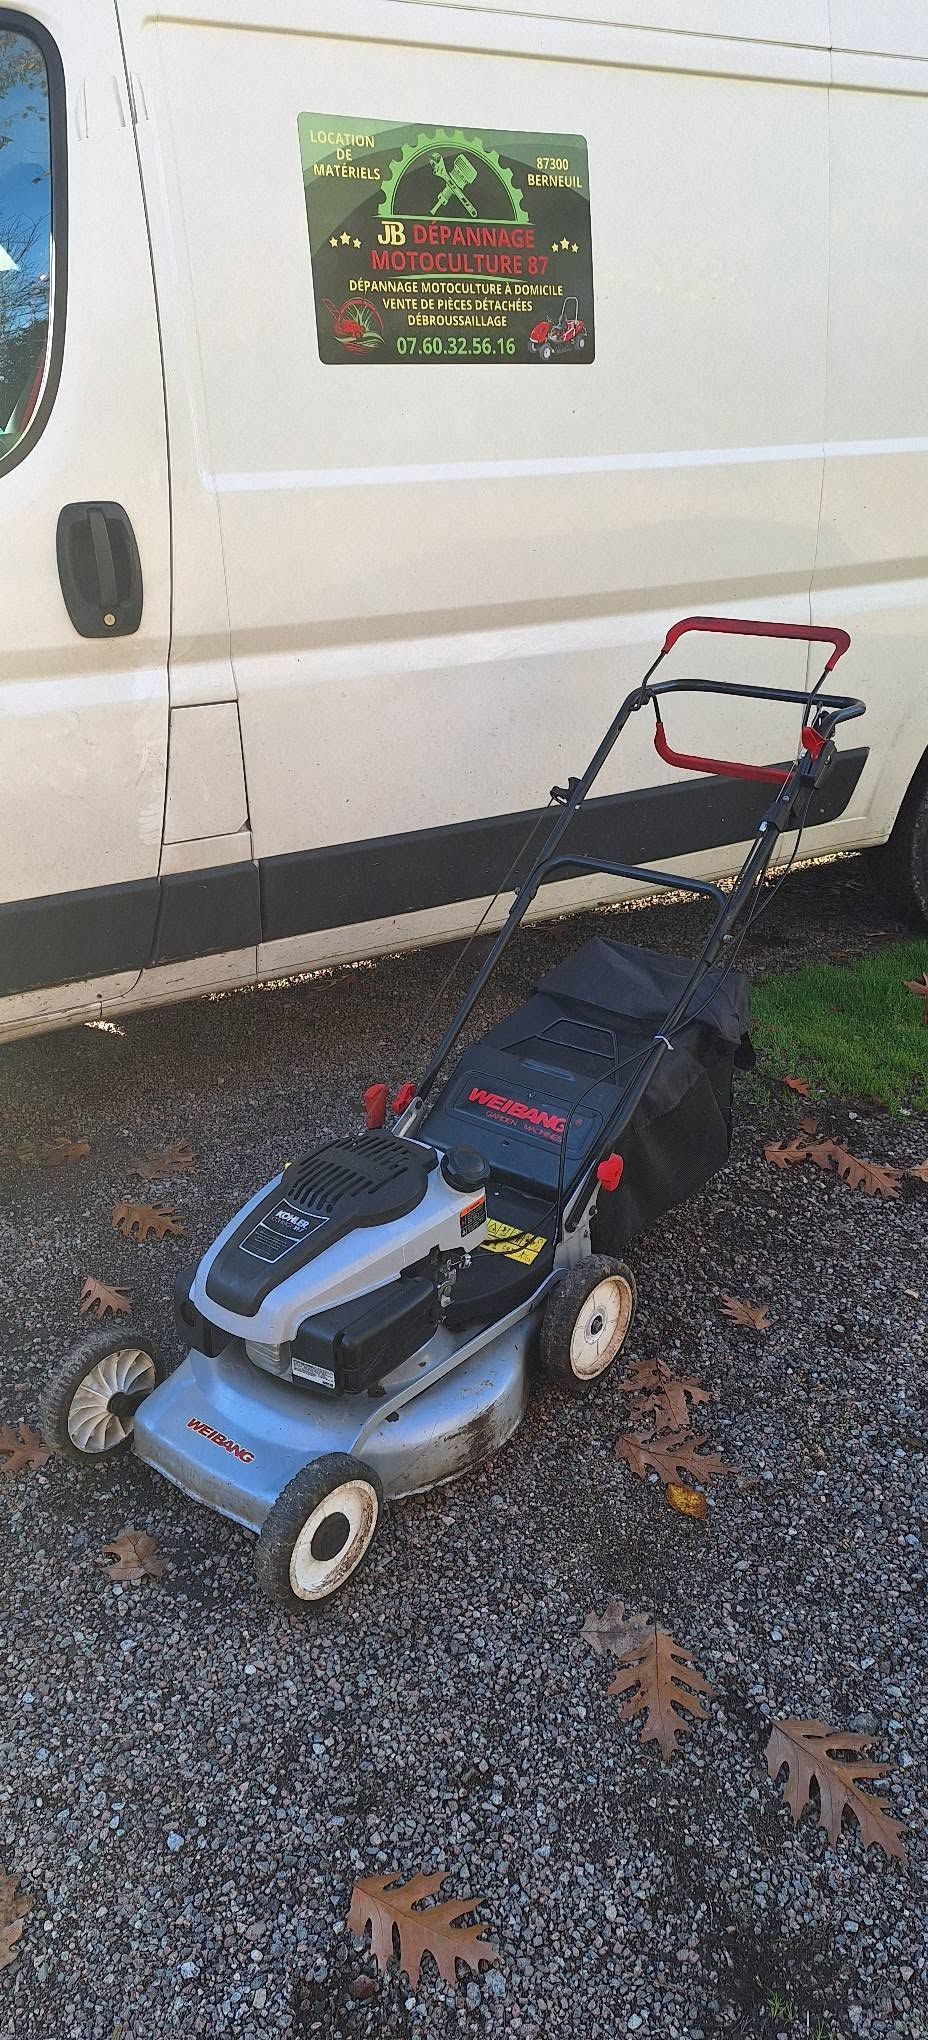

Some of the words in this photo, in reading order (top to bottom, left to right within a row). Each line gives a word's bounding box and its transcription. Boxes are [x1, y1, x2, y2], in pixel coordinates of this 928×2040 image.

[310, 130, 375, 148] LOCATION
[336, 149, 353, 161] DE
[536, 157, 569, 171] 87300
[313, 162, 381, 180] MATÉRIELS
[527, 174, 583, 188] BERNEUIL
[377, 221, 406, 246] JB
[413, 221, 535, 248] DÉPANNAGE
[371, 251, 523, 275] MOTOCULTURE
[527, 256, 548, 276] 87
[349, 278, 419, 293] DÉPANNAGE
[421, 282, 502, 295] MOTOCULTURE
[504, 280, 513, 295] À
[515, 284, 563, 296] DOMICILE
[382, 298, 418, 310] VENTE
[420, 298, 435, 310] DE
[437, 296, 472, 311] PIÈCES
[475, 298, 533, 312] DÉTACHÉES
[408, 312, 508, 327] DÉBROUSSAILLAGE
[396, 337, 516, 356] 07.60.32.56.16
[468, 1087, 567, 1133] WEIBANG
[275, 1210, 310, 1229] KOHLER
[186, 1417, 256, 1465] WEIBANG
